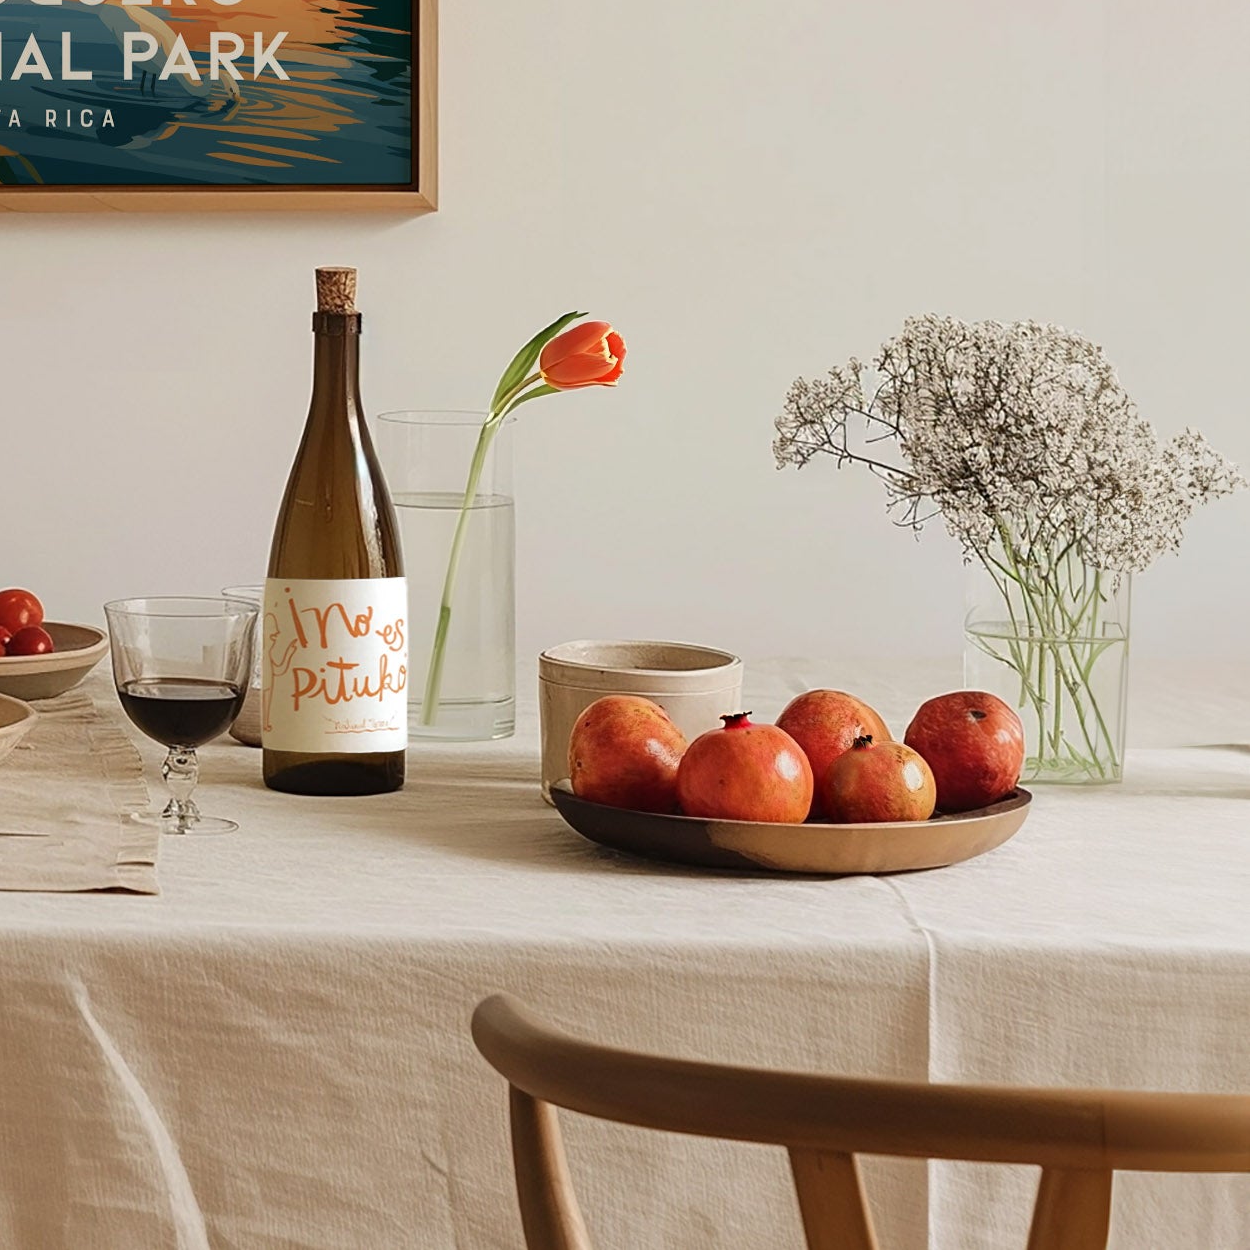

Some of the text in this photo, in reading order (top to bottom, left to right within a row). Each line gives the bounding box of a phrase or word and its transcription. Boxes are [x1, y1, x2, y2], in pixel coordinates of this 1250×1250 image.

[122, 31, 292, 82] PARK
[45, 108, 116, 129] RICA
[375, 618, 405, 652] es
